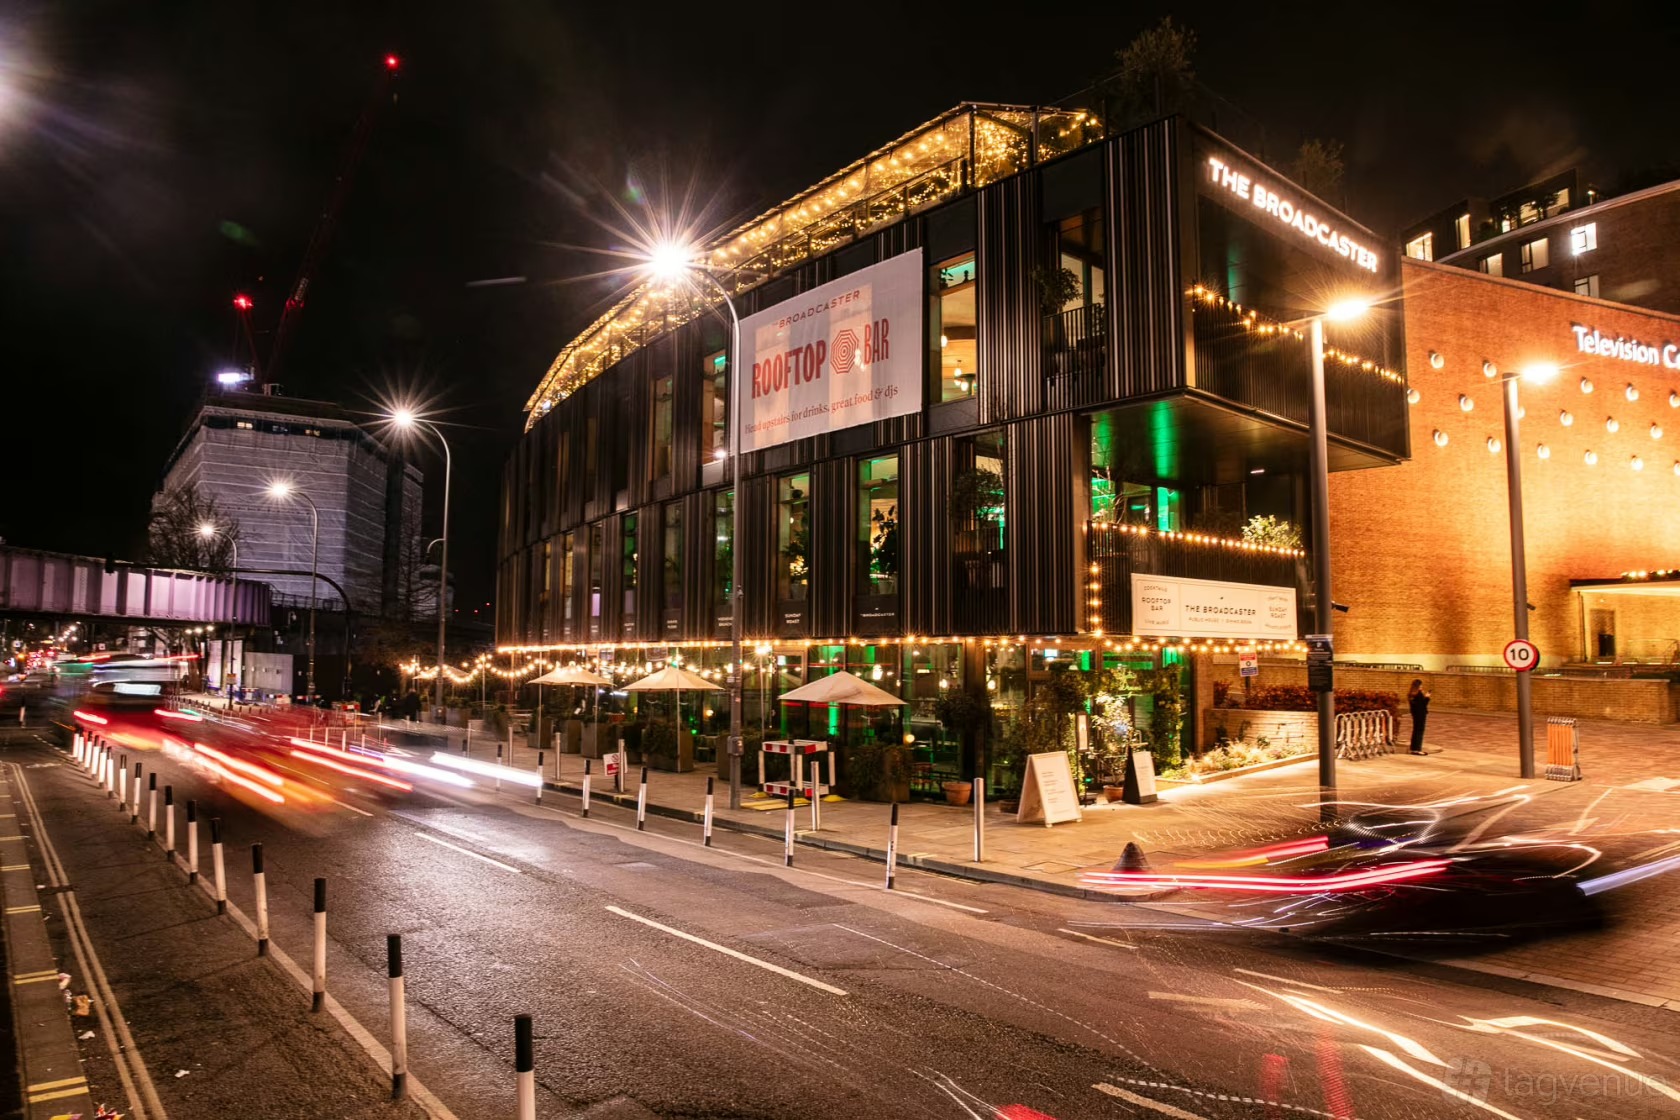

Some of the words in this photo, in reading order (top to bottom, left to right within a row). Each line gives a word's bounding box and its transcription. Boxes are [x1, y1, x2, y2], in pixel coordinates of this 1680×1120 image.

[1208, 157, 1251, 200] THE
[1253, 184, 1379, 273] BROADCASTER
[779, 290, 860, 329] BROADCASTER
[751, 339, 827, 400] ROOFTOP
[863, 317, 890, 366] BAR
[1571, 325, 1660, 366] Television
[745, 422, 762, 434] Head
[762, 412, 791, 432] upstairs
[791, 410, 803, 422] for
[803, 402, 830, 419] drinks,
[831, 397, 853, 414] great
[854, 390, 874, 405] food
[874, 387, 884, 400] &
[884, 384, 899, 398] djs
[1141, 596, 1172, 605] ROOFTOP
[1185, 604, 1200, 613] THE
[1203, 605, 1256, 616] BROADCASTER
[1510, 648, 1529, 661] 10
